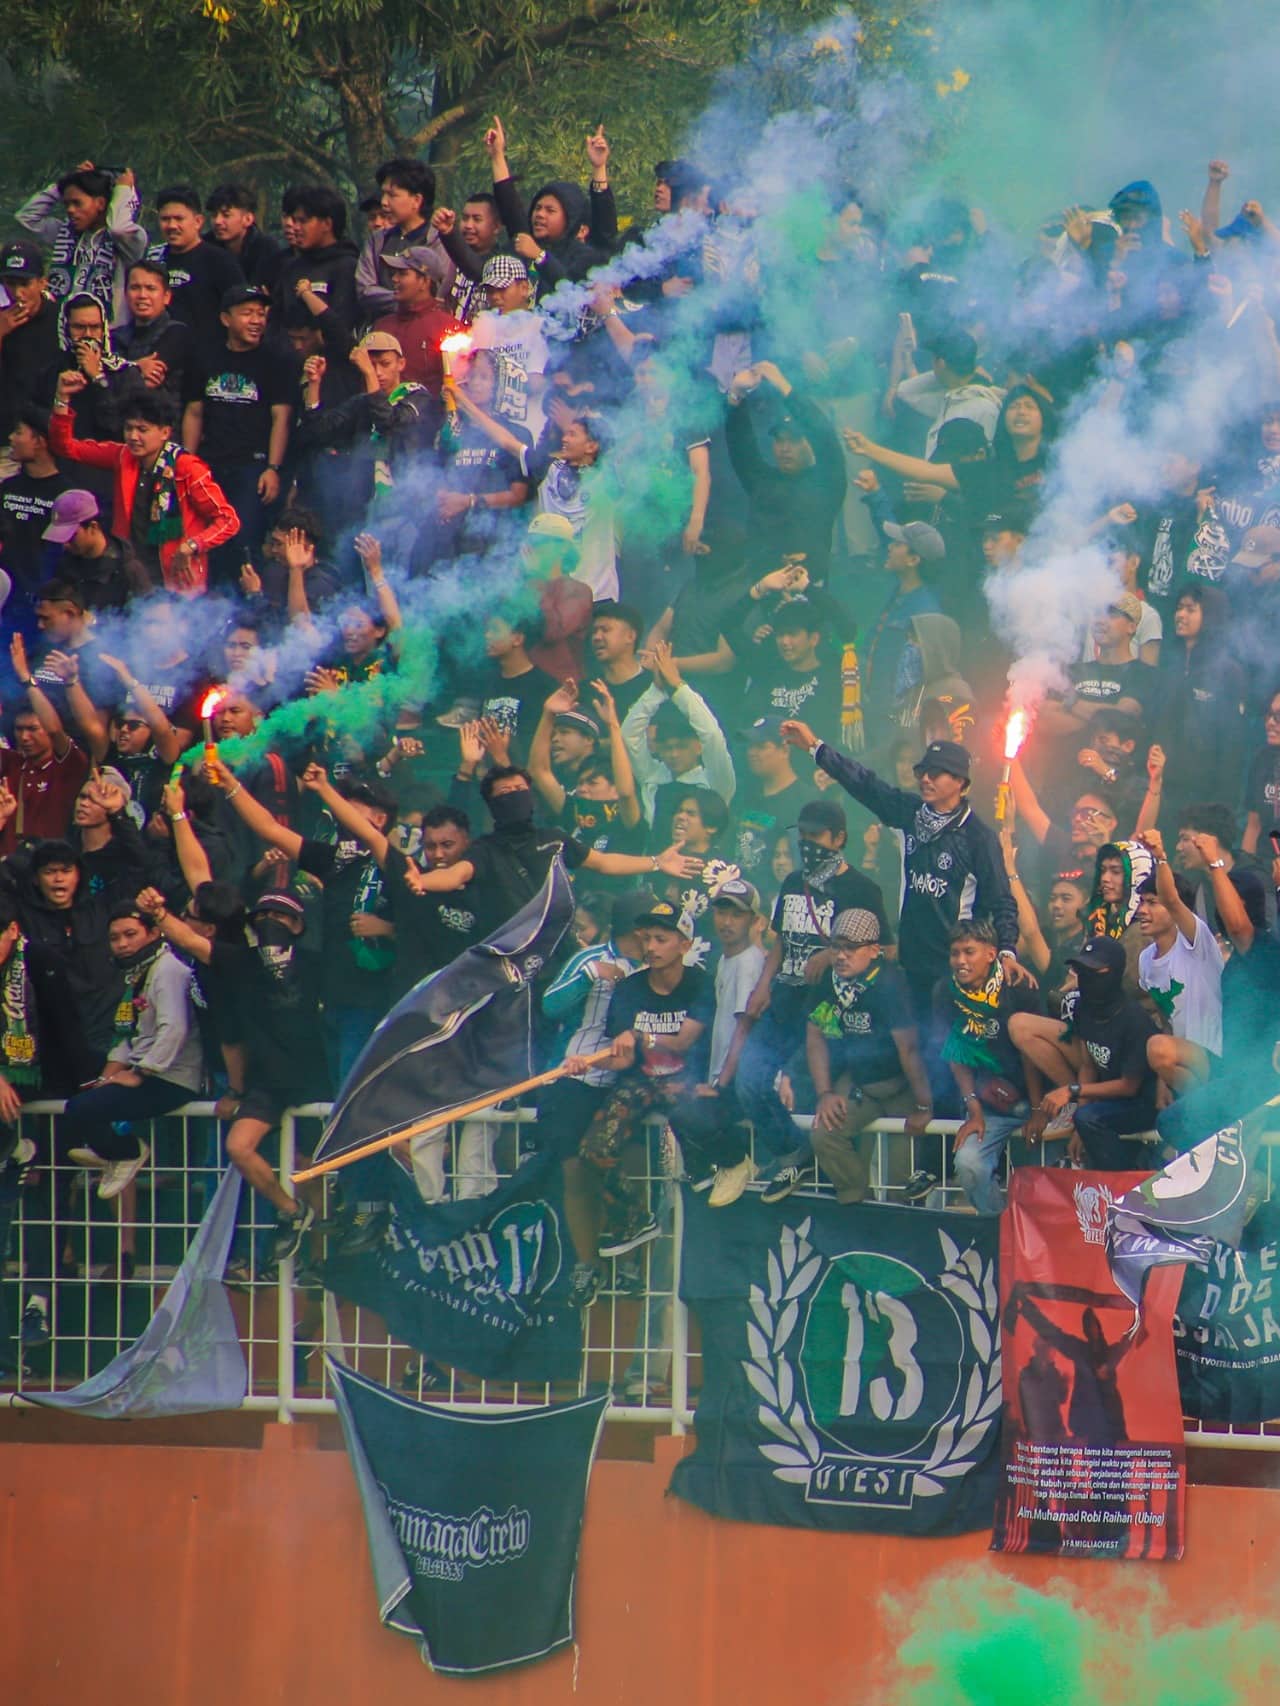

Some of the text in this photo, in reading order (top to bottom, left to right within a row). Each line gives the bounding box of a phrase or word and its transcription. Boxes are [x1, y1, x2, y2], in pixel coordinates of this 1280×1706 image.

[503, 1220, 544, 1295] 17
[839, 1282, 924, 1421] 13
[1040, 1479, 1062, 1489] tubuh
[1102, 1492, 1125, 1502] Tenang
[1080, 1511, 1101, 1522] Robi
[1103, 1512, 1133, 1523] Raihan
[1134, 1512, 1165, 1526] (Ubing)
